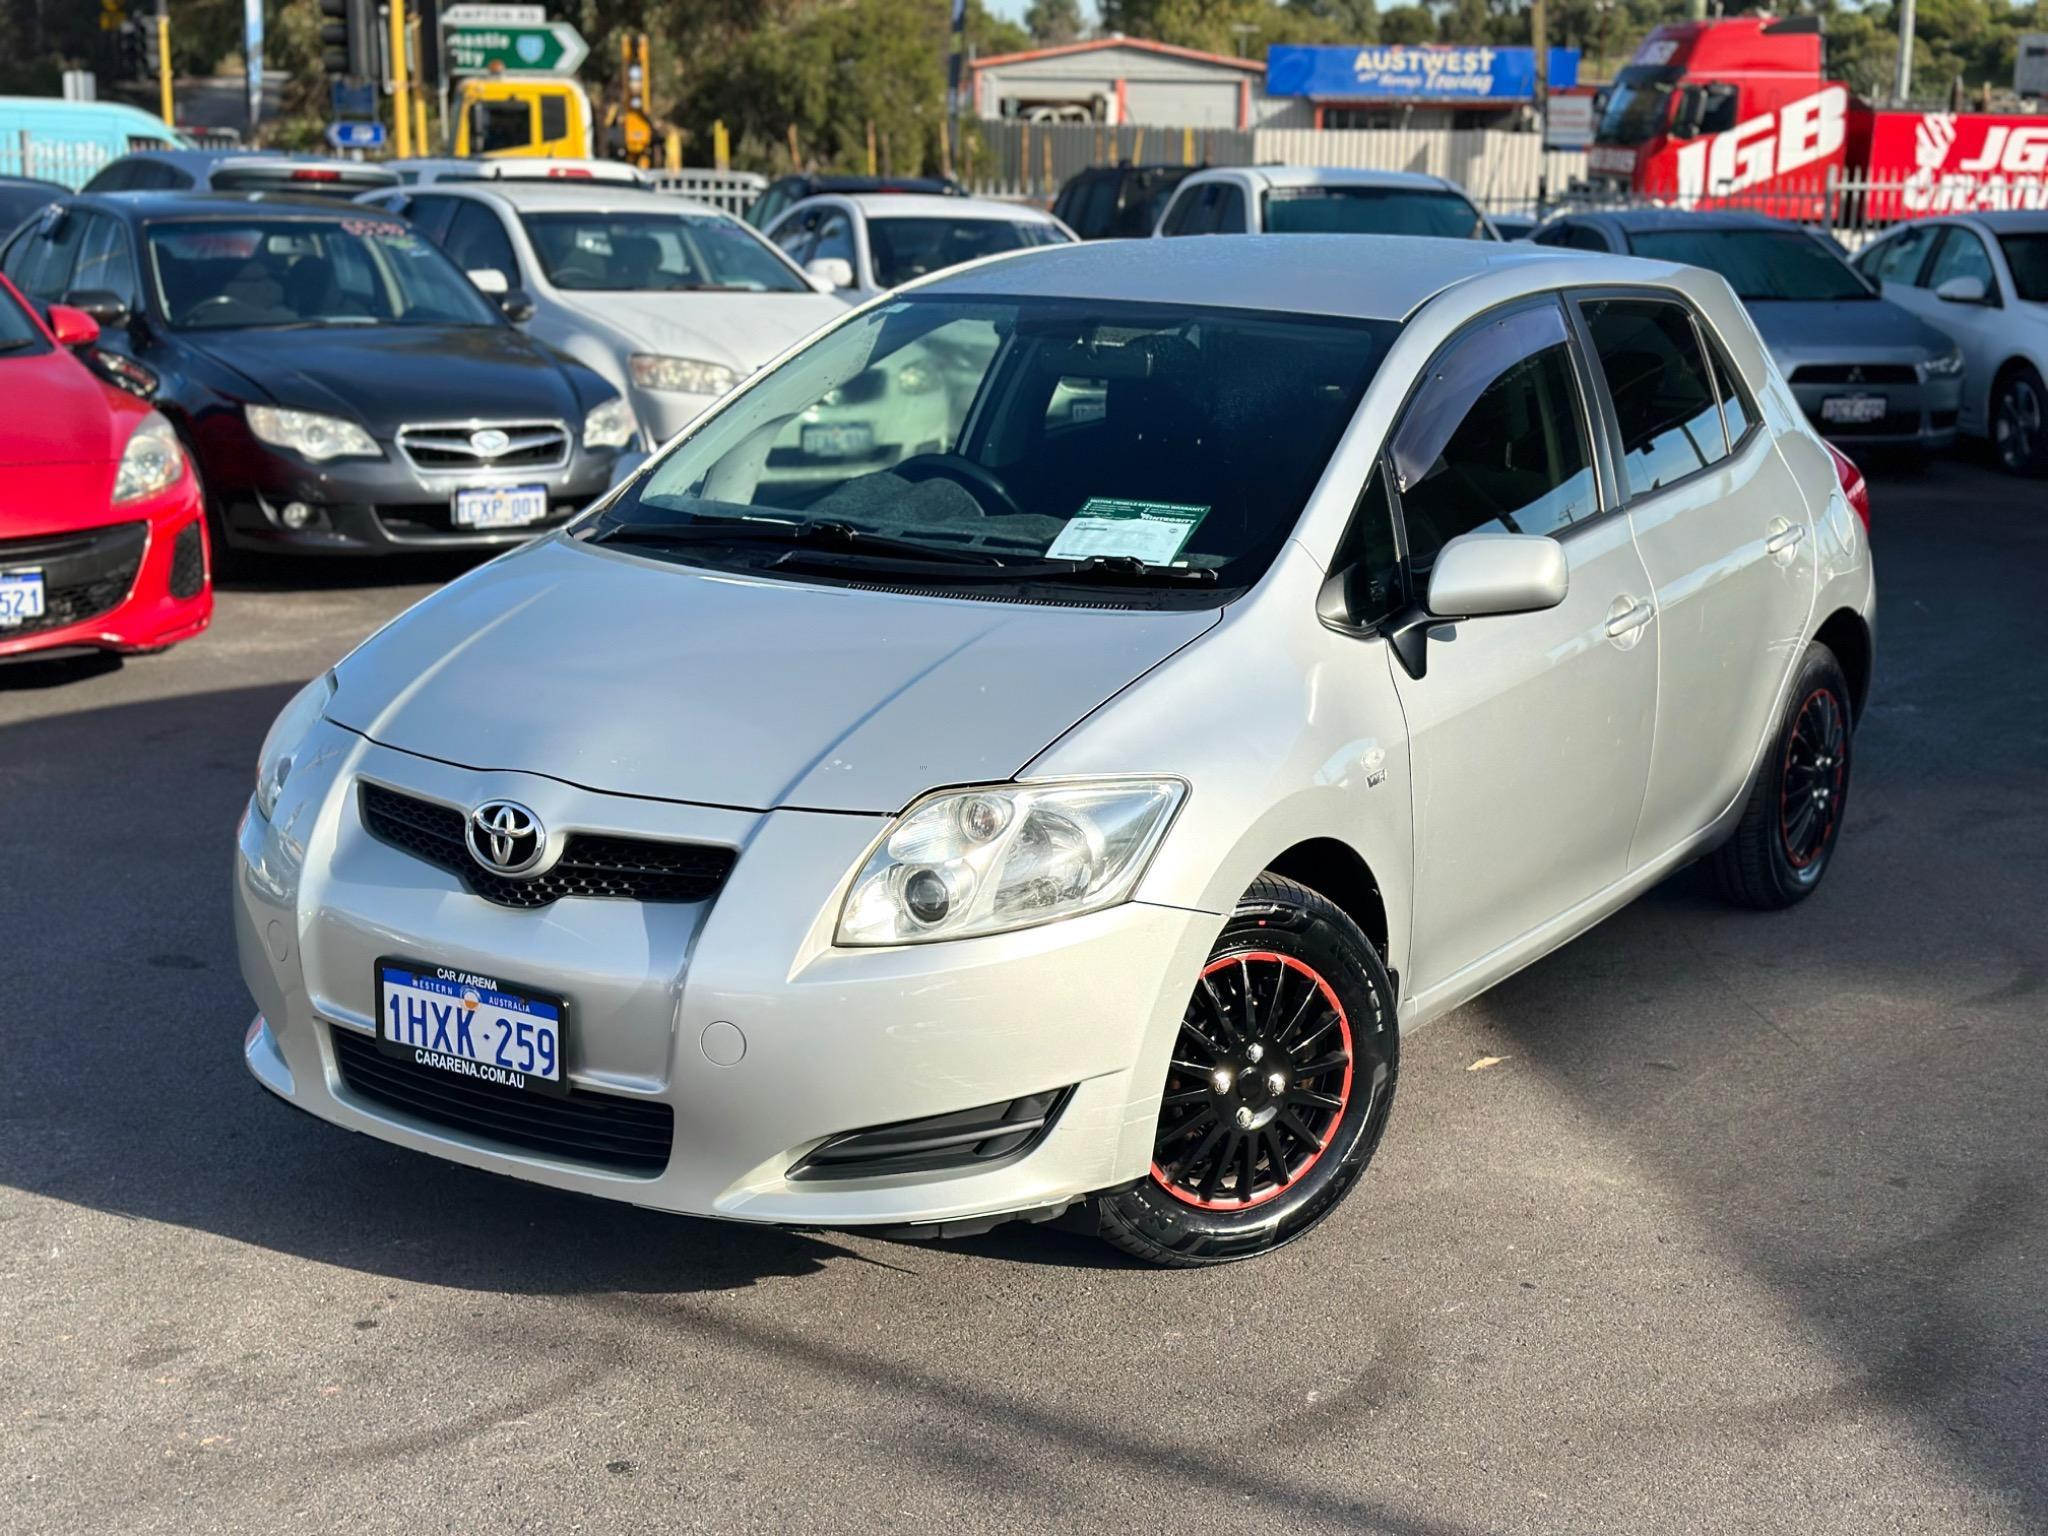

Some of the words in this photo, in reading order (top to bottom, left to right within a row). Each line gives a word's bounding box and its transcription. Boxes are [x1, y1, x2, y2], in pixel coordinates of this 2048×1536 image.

[1354, 46, 1497, 73] AUSTWEST
[437, 967, 456, 983] CAR
[465, 975, 498, 992] ARENA
[412, 978, 453, 996] WESTERN
[488, 997, 531, 1014] AUSTRALIA
[415, 1048, 525, 1089] CARARENA.COM.AU
